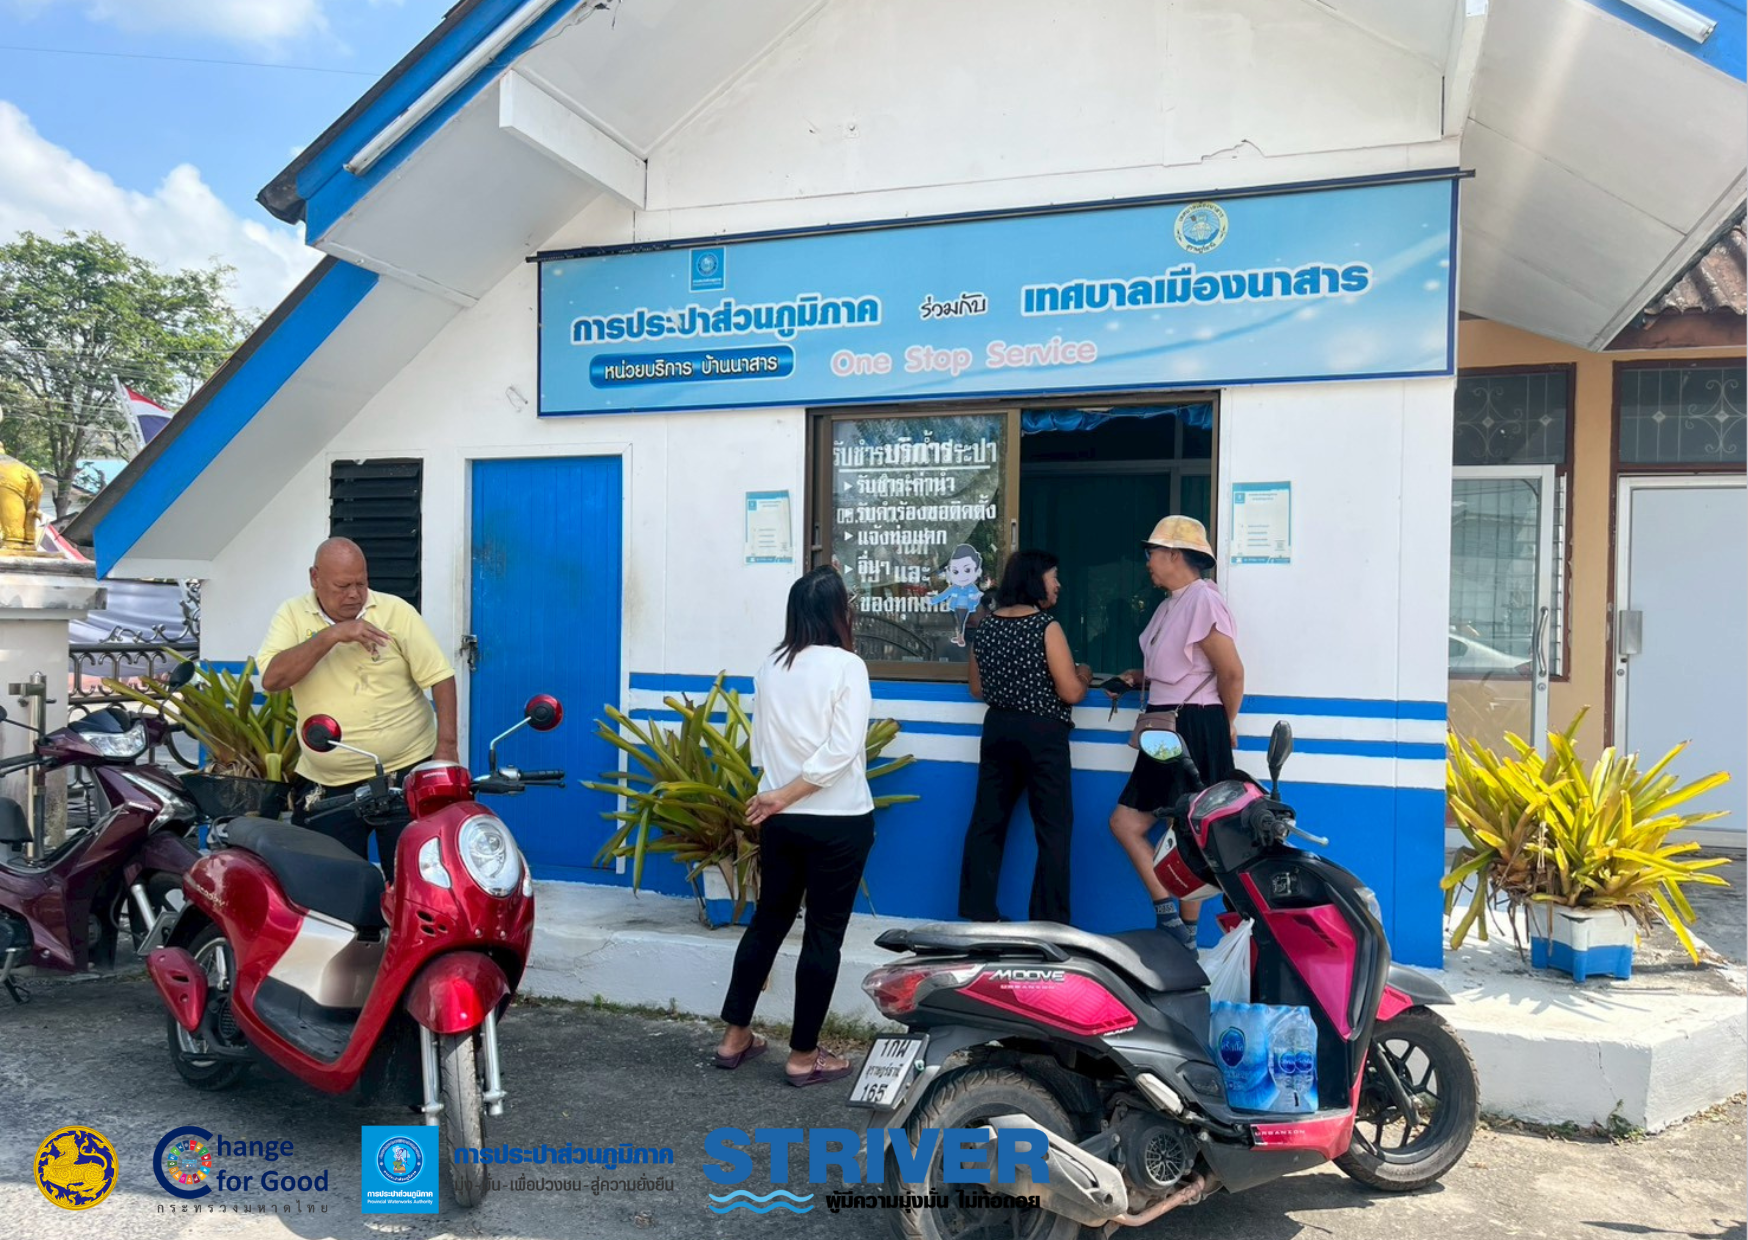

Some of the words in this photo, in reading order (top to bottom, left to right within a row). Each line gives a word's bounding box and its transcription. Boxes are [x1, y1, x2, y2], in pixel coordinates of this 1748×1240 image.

[1021, 263, 1371, 313] เทศบาลเมืองนาสาร
[571, 295, 880, 342] การประปาส่วนภูมิภาค
[920, 293, 987, 319] ร่วมกับ
[604, 359, 692, 380] หน่วยบริการ
[701, 354, 778, 376] บ้านนาสาร
[832, 350, 891, 376] One
[905, 346, 971, 376] Stop
[986, 337, 1097, 368] Service
[989, 970, 1066, 982] MOOVE
[861, 1083, 889, 1103] 165
